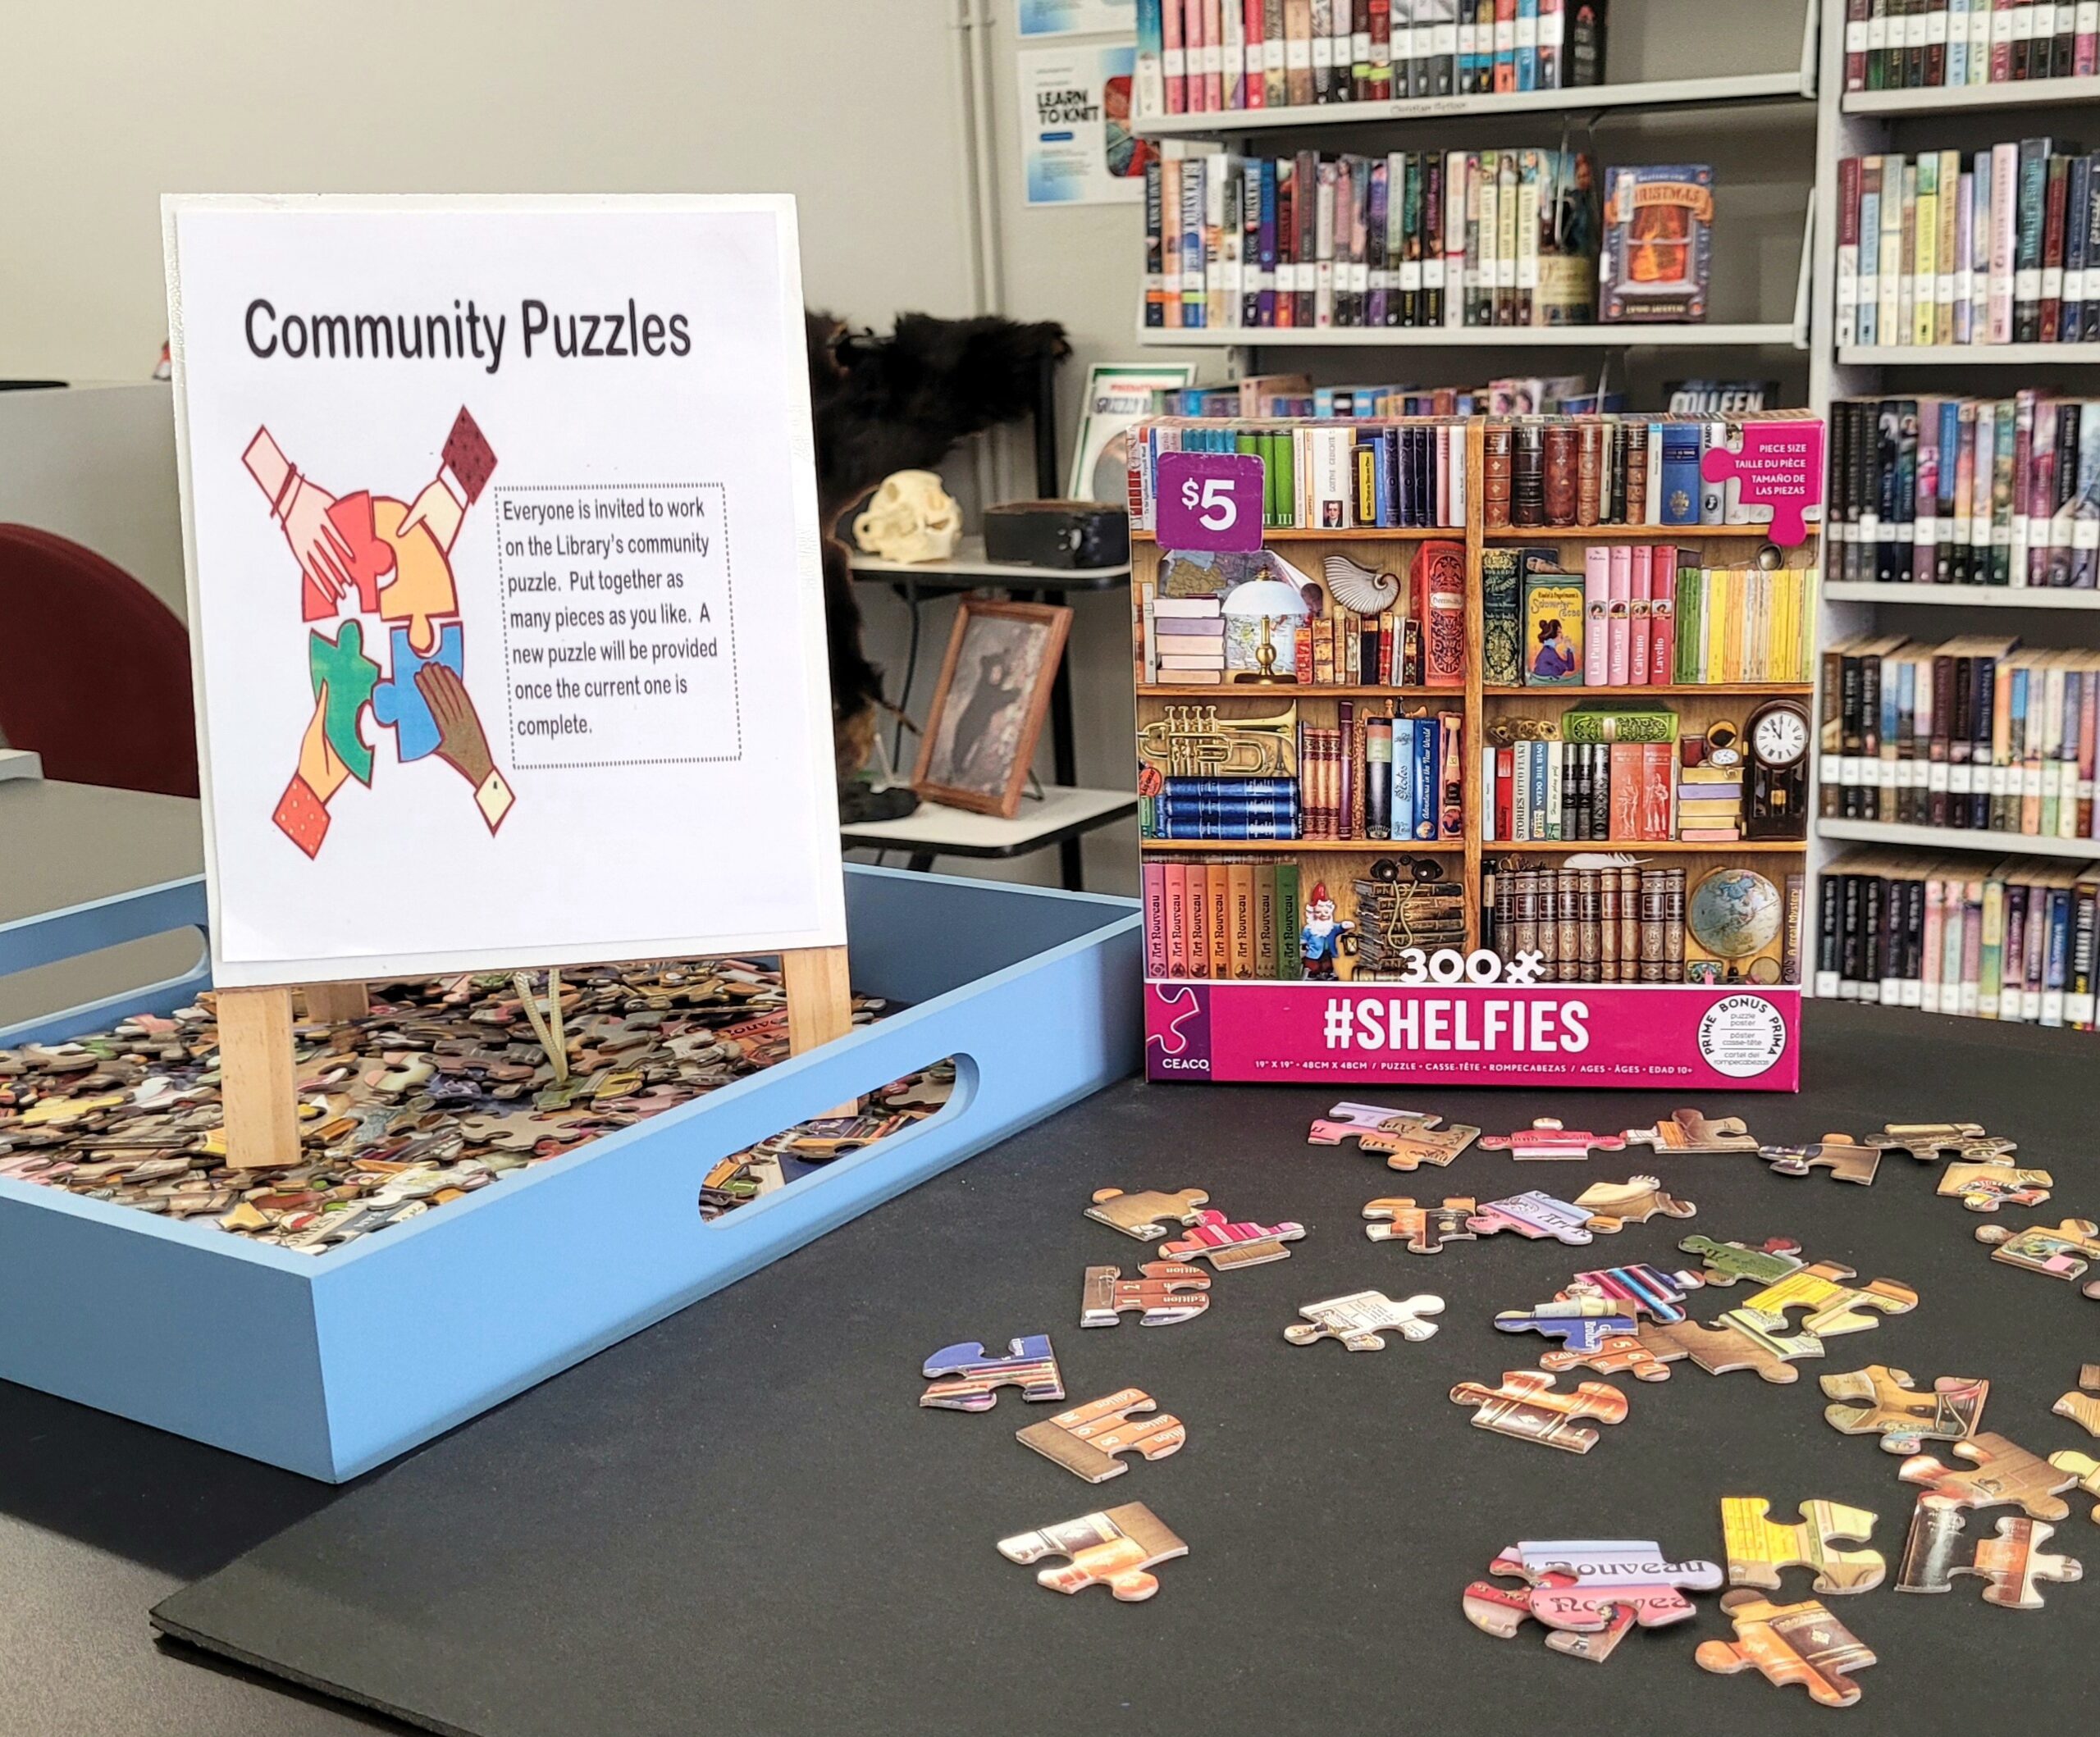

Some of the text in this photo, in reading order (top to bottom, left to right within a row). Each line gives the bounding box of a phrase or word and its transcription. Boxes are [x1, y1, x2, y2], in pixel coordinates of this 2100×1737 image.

[1037, 90, 1088, 107] LEARN
[1039, 107, 1100, 125] TO KNIT
[245, 298, 692, 374] Community Puzzles
[1759, 444, 1807, 453] PIECE SIZE
[1734, 458, 1807, 468] TAILLE DU PIÈCE
[1751, 474, 1806, 484] TAMAÑO DE
[1755, 486, 1806, 495] LAS PIEZAS
[504, 495, 705, 525] Everyone is invited to work
[1180, 476, 1237, 531] $5
[505, 532, 709, 559] on the Library's community
[508, 568, 683, 598] puzzle. Put together as
[510, 602, 711, 632] many pieces as you like. A
[513, 636, 718, 668] new puzzle will be provided
[1590, 662, 1600, 676] La
[515, 673, 687, 700] once the current one is
[517, 713, 592, 740] complete.
[1516, 797, 1524, 839] STORIES
[1399, 948, 1501, 984] 300
[1323, 999, 1590, 1051] #SHELFIES
[1701, 997, 1783, 1055] PRIME BONUS PRIMA
[1162, 1058, 1208, 1069] CEACO
[1302, 1061, 1330, 1069] 48CM
[1340, 1062, 1367, 1070] 48CM
[1381, 1062, 1417, 1071] PUZZLE
[1425, 1060, 1480, 1072] CASSE-TÊTE
[1489, 1064, 1567, 1073] ROMPECABEZAS
[1580, 1065, 1606, 1074] AGES
[1648, 1066, 1676, 1074] EDAD
[1678, 1066, 1693, 1074] 10+
